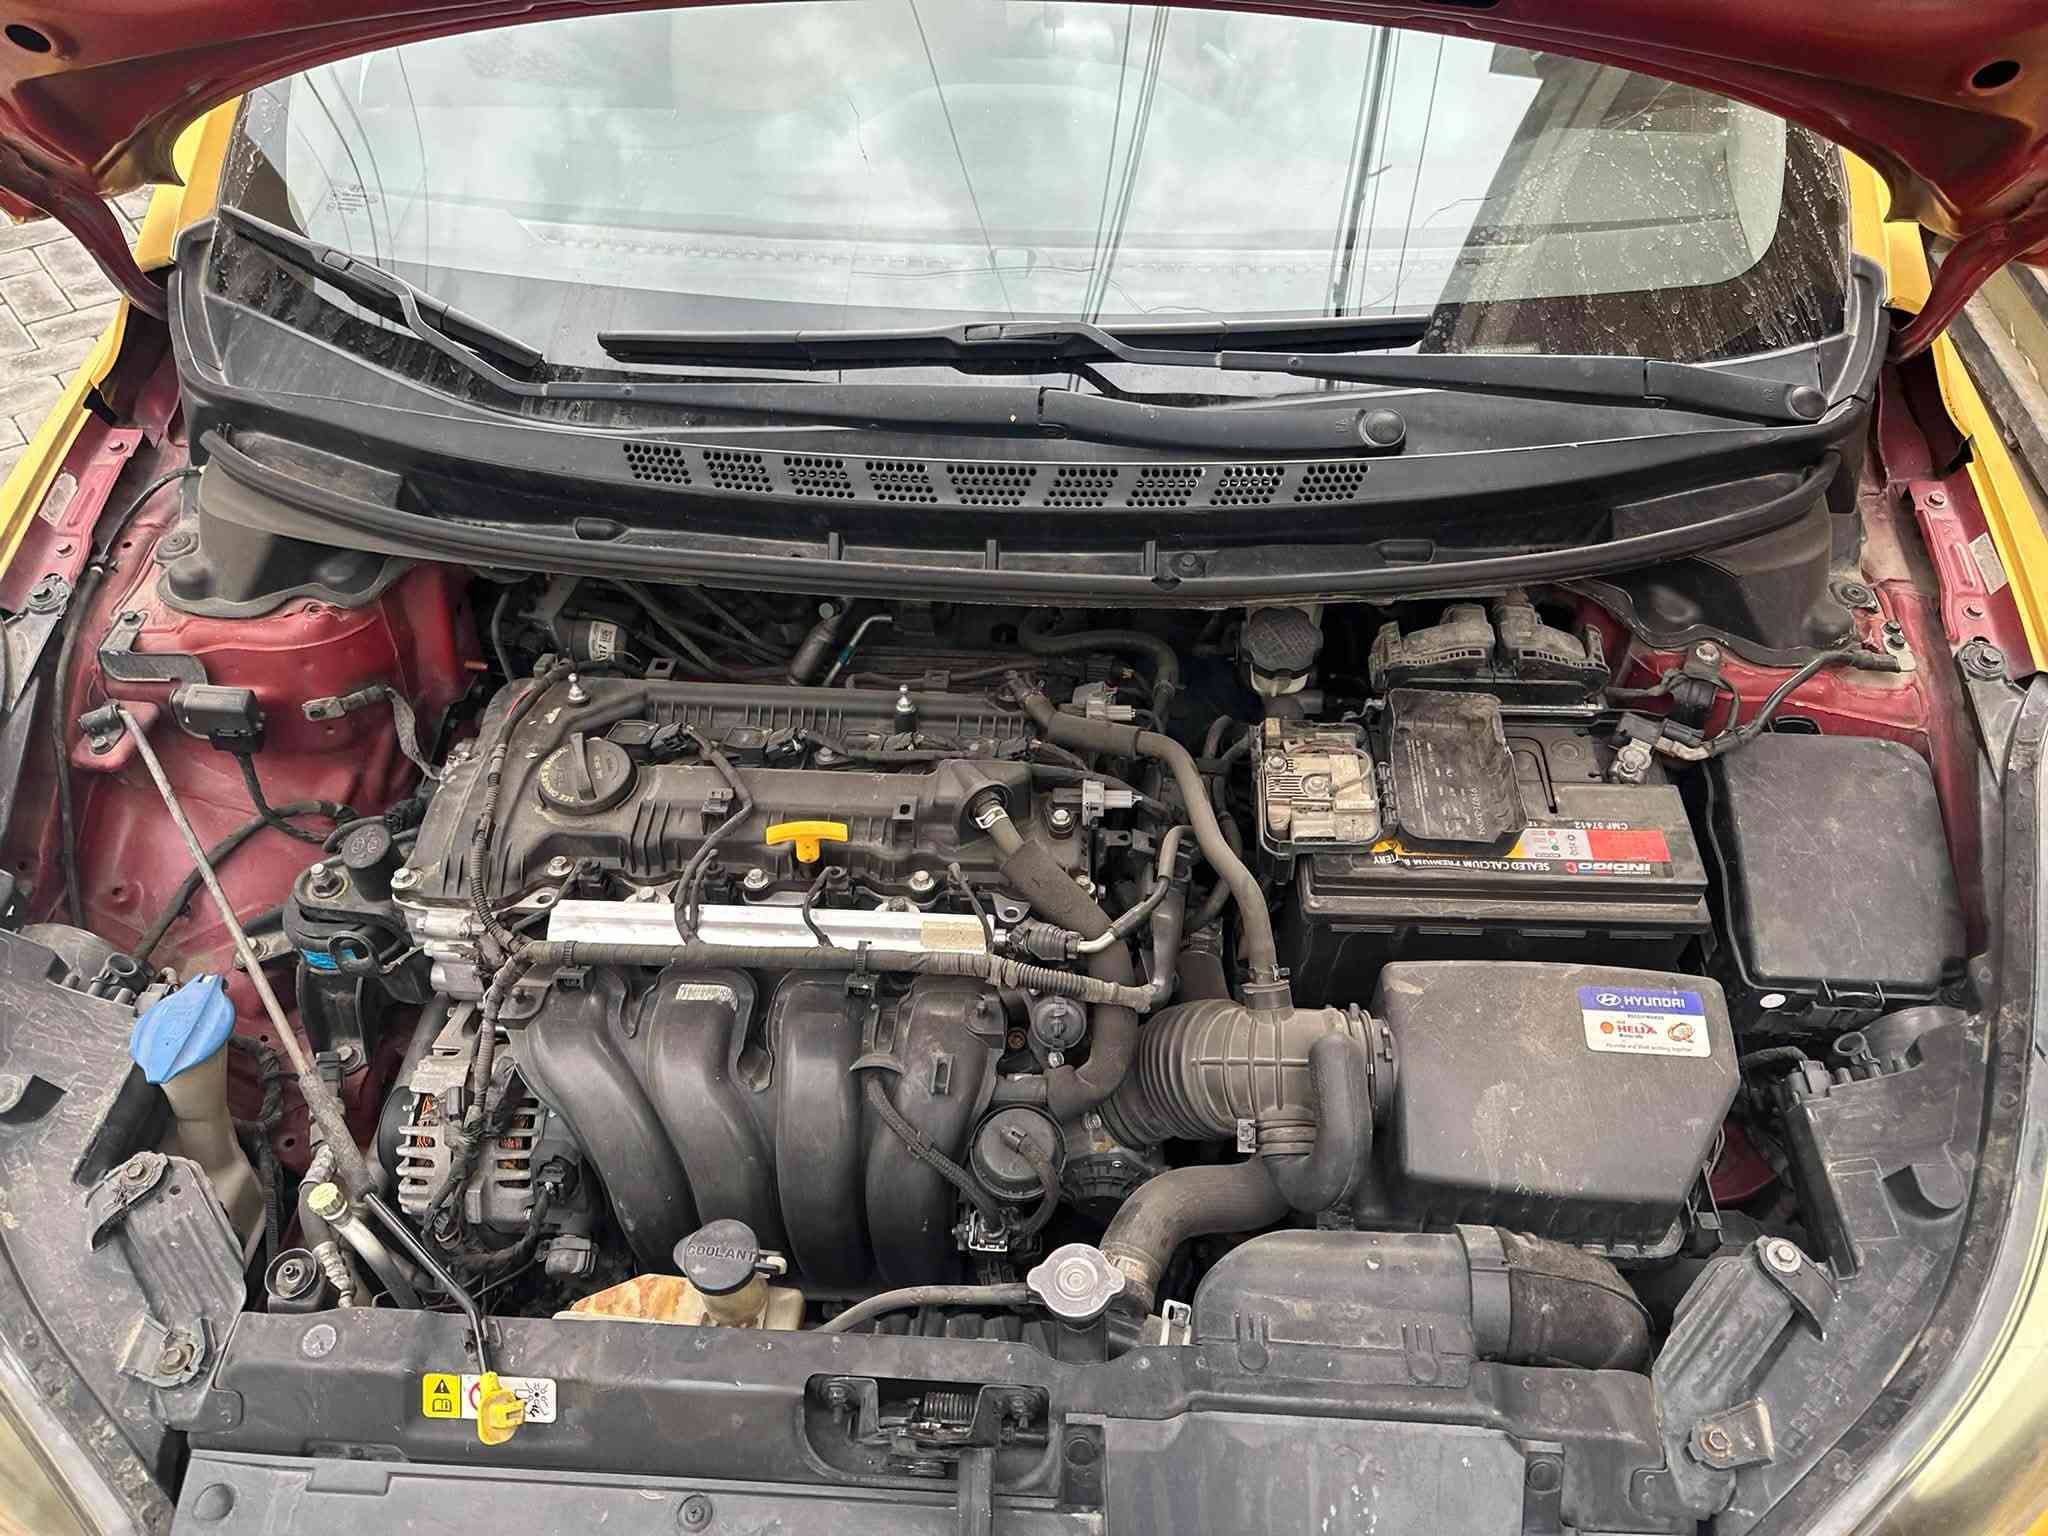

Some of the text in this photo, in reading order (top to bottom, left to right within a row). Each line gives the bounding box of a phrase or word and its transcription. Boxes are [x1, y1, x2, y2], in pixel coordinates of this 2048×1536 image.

[1462, 860, 1510, 870] CALCIUM
[1511, 862, 1551, 872] SEALED
[1623, 995, 1685, 1009] HYUNDAI
[687, 1244, 757, 1263] COOLANT
